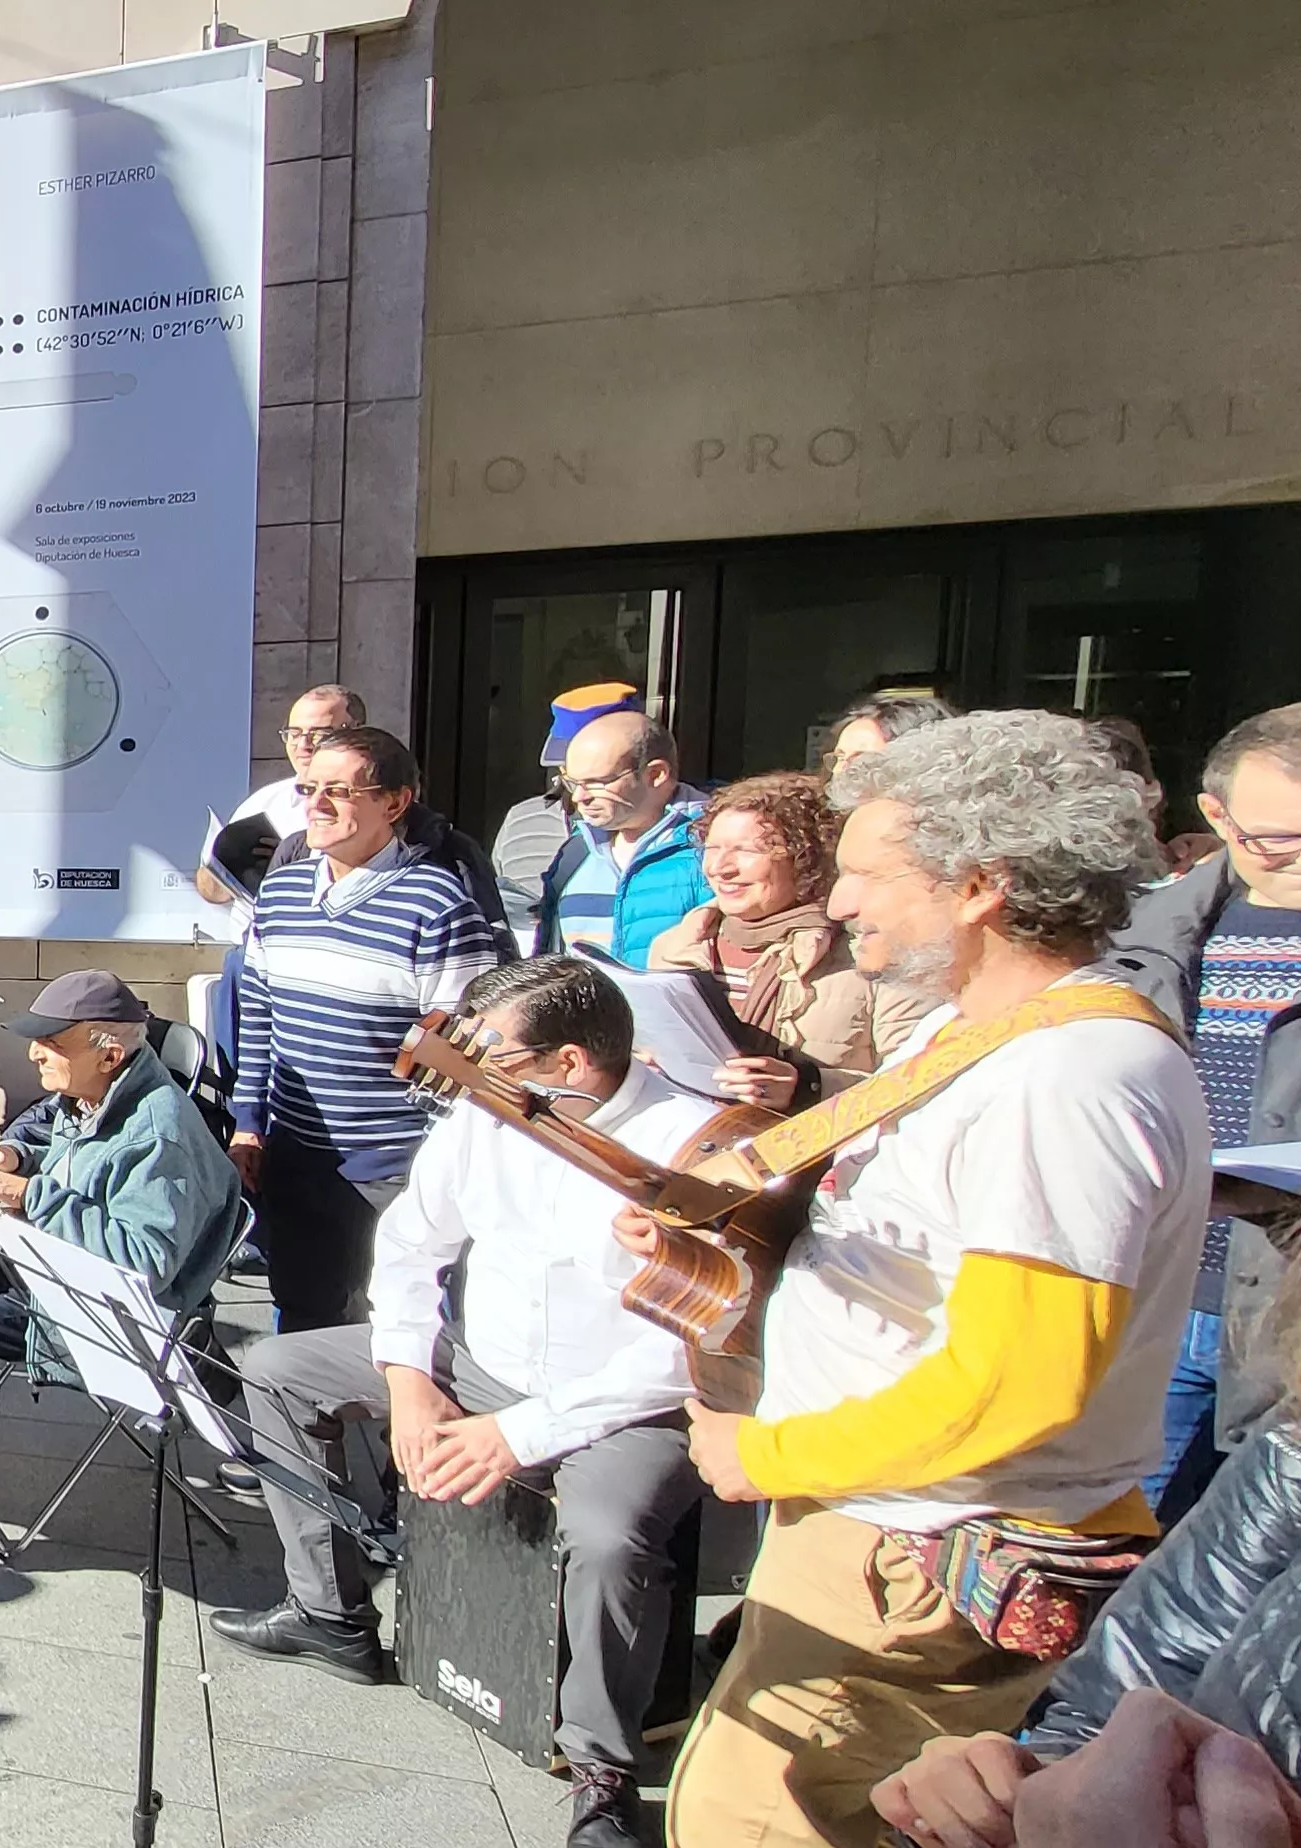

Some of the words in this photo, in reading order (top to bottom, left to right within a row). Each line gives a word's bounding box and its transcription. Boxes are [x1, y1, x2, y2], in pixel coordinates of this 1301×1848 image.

[38, 174, 93, 195] ESTHER
[95, 165, 156, 188] PIZARRO
[36, 291, 172, 324] CONTAMINACIÓN
[176, 284, 245, 308] HÍDRICA
[693, 396, 1261, 477] PROVINCIAL
[35, 503, 43, 514] 6
[44, 501, 85, 513] octubre
[96, 499, 107, 510] 19
[108, 495, 166, 509] noviembre
[167, 491, 196, 505] 2023
[35, 535, 56, 547] Sala
[57, 534, 71, 546] de
[72, 531, 136, 546] exposiciones
[35, 551, 87, 566] Diputación
[88, 549, 102, 560] de
[103, 547, 141, 559] Huesca
[73, 880, 112, 888] HUESCA
[437, 1658, 502, 1719] Sela
